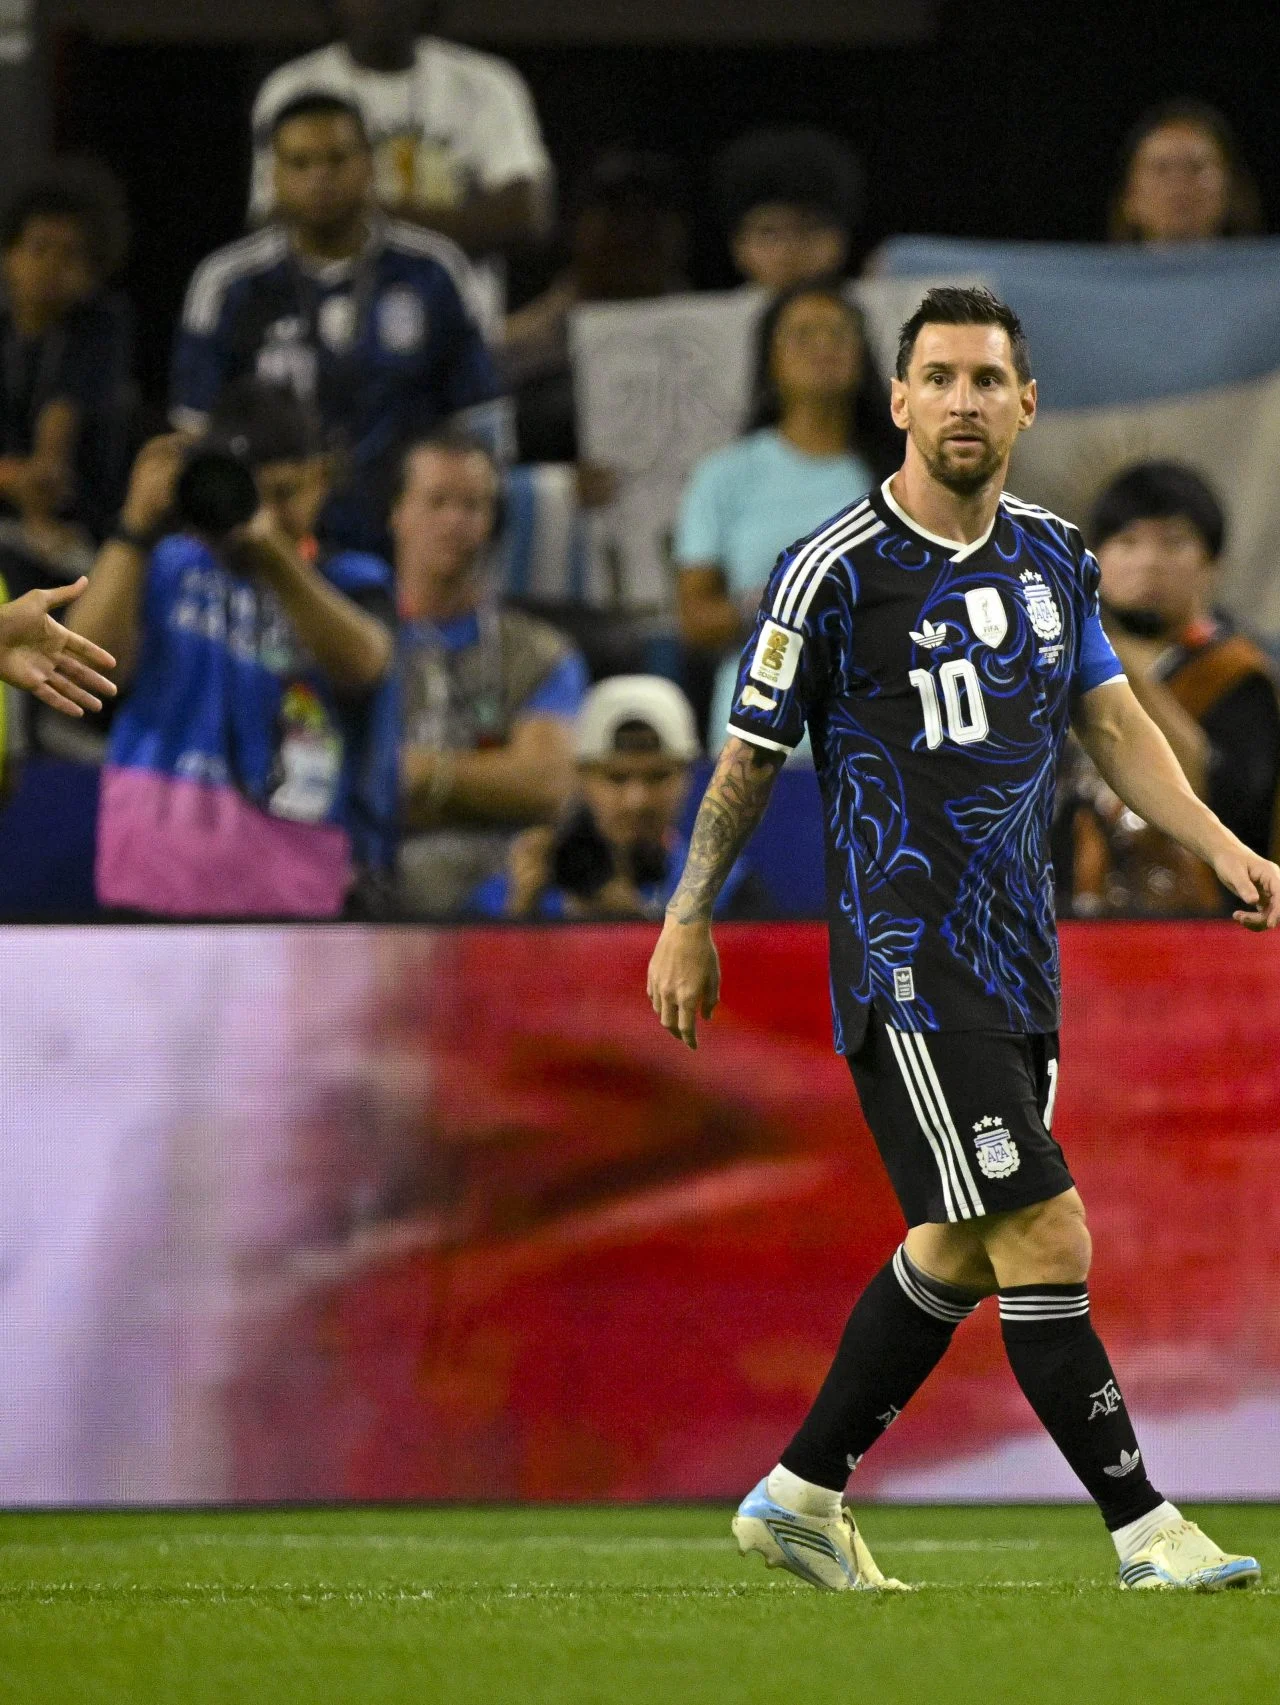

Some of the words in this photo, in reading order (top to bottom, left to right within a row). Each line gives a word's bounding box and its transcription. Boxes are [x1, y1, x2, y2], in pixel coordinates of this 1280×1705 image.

[908, 658, 990, 750] 10
[986, 1142, 1009, 1163] AFA
[1088, 1379, 1121, 1420] AFA
